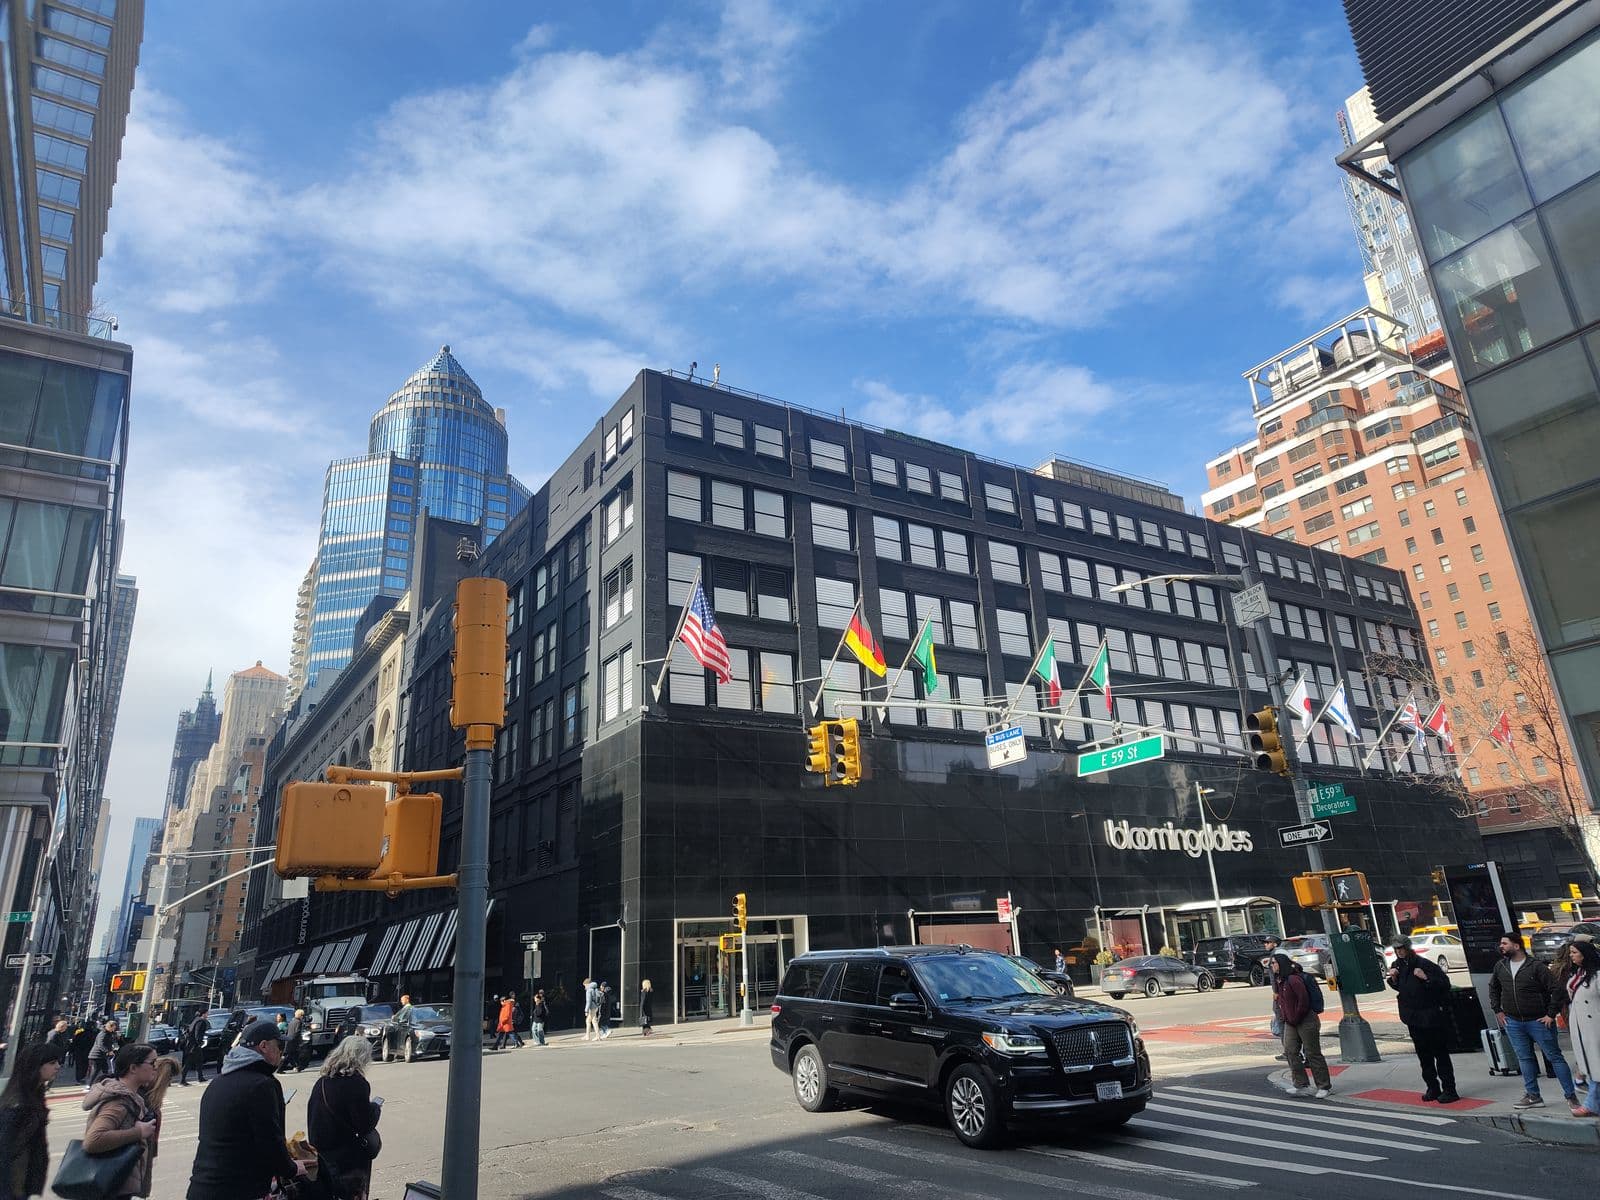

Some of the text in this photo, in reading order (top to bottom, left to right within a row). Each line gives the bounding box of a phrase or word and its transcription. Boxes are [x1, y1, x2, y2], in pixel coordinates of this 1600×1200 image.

[1247, 586, 1261, 596] BLOCK
[1249, 595, 1260, 603] BOX
[995, 728, 1020, 742] BUS LANE
[1101, 745, 1138, 767] E 59 St
[1319, 788, 1325, 800] E
[1325, 786, 1335, 799] 59
[1316, 800, 1350, 812] Decorators
[1287, 828, 1323, 841] ONE WAY
